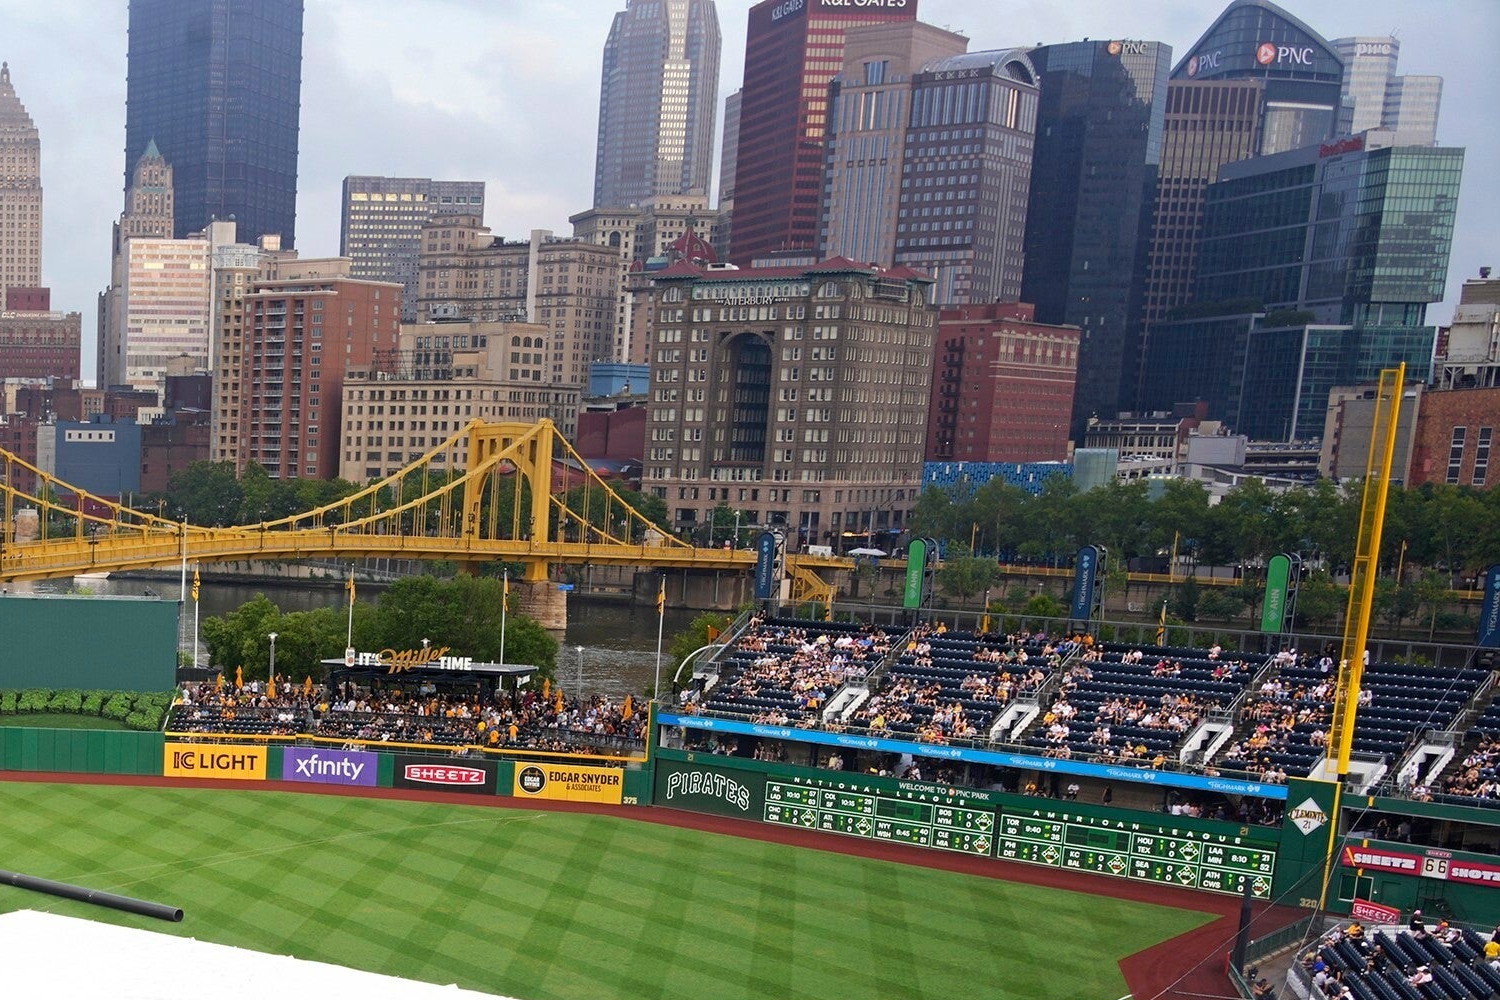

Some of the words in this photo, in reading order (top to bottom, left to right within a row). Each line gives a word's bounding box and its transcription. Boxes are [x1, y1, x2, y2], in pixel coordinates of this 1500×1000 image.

[1122, 43, 1148, 54] PNC
[1199, 51, 1221, 72] PNC
[1277, 47, 1313, 65] PNC
[910, 570, 918, 589] AHN
[1271, 588, 1280, 610] AHN
[378, 647, 450, 675] Miller
[439, 657, 472, 671] TIME
[918, 746, 950, 757] HIGHMARK
[173, 752, 195, 769] IC
[200, 753, 258, 770] LIGHT
[1009, 757, 1043, 767] HIGHMARK
[296, 754, 364, 780] xfinity
[411, 767, 480, 782] SHEETZ
[550, 771, 581, 783] EDGAR
[582, 774, 619, 785] SNYDER
[1106, 768, 1143, 780] HIGHMARK
[571, 784, 601, 792] ASSOCIATES
[666, 772, 750, 810] PIRATES
[794, 777, 880, 794] NATIONAL
[896, 791, 965, 806] LEAGUE
[899, 782, 935, 793] WELCOME
[956, 789, 970, 799] PNC
[971, 791, 990, 800] PARK
[1208, 781, 1247, 793] HIGHMARK
[623, 797, 637, 805] 375
[1006, 818, 1020, 826] TOR
[1290, 808, 1327, 826] CLEMENTE
[1025, 825, 1041, 833] 9:40
[1033, 810, 1139, 830] AMERICAN
[1159, 827, 1241, 844] LEAGUE
[1240, 827, 1248, 835] 21
[1303, 821, 1311, 830] 21
[1137, 837, 1153, 845] HOU
[1137, 846, 1151, 854] TEX
[1209, 847, 1223, 855] LAA
[1208, 856, 1222, 864] MIN
[1231, 855, 1247, 863] 8:10
[1353, 853, 1416, 869] SHEETZ
[1205, 871, 1220, 879] ATH
[1203, 880, 1220, 888] CWS
[1300, 897, 1317, 908] 320
